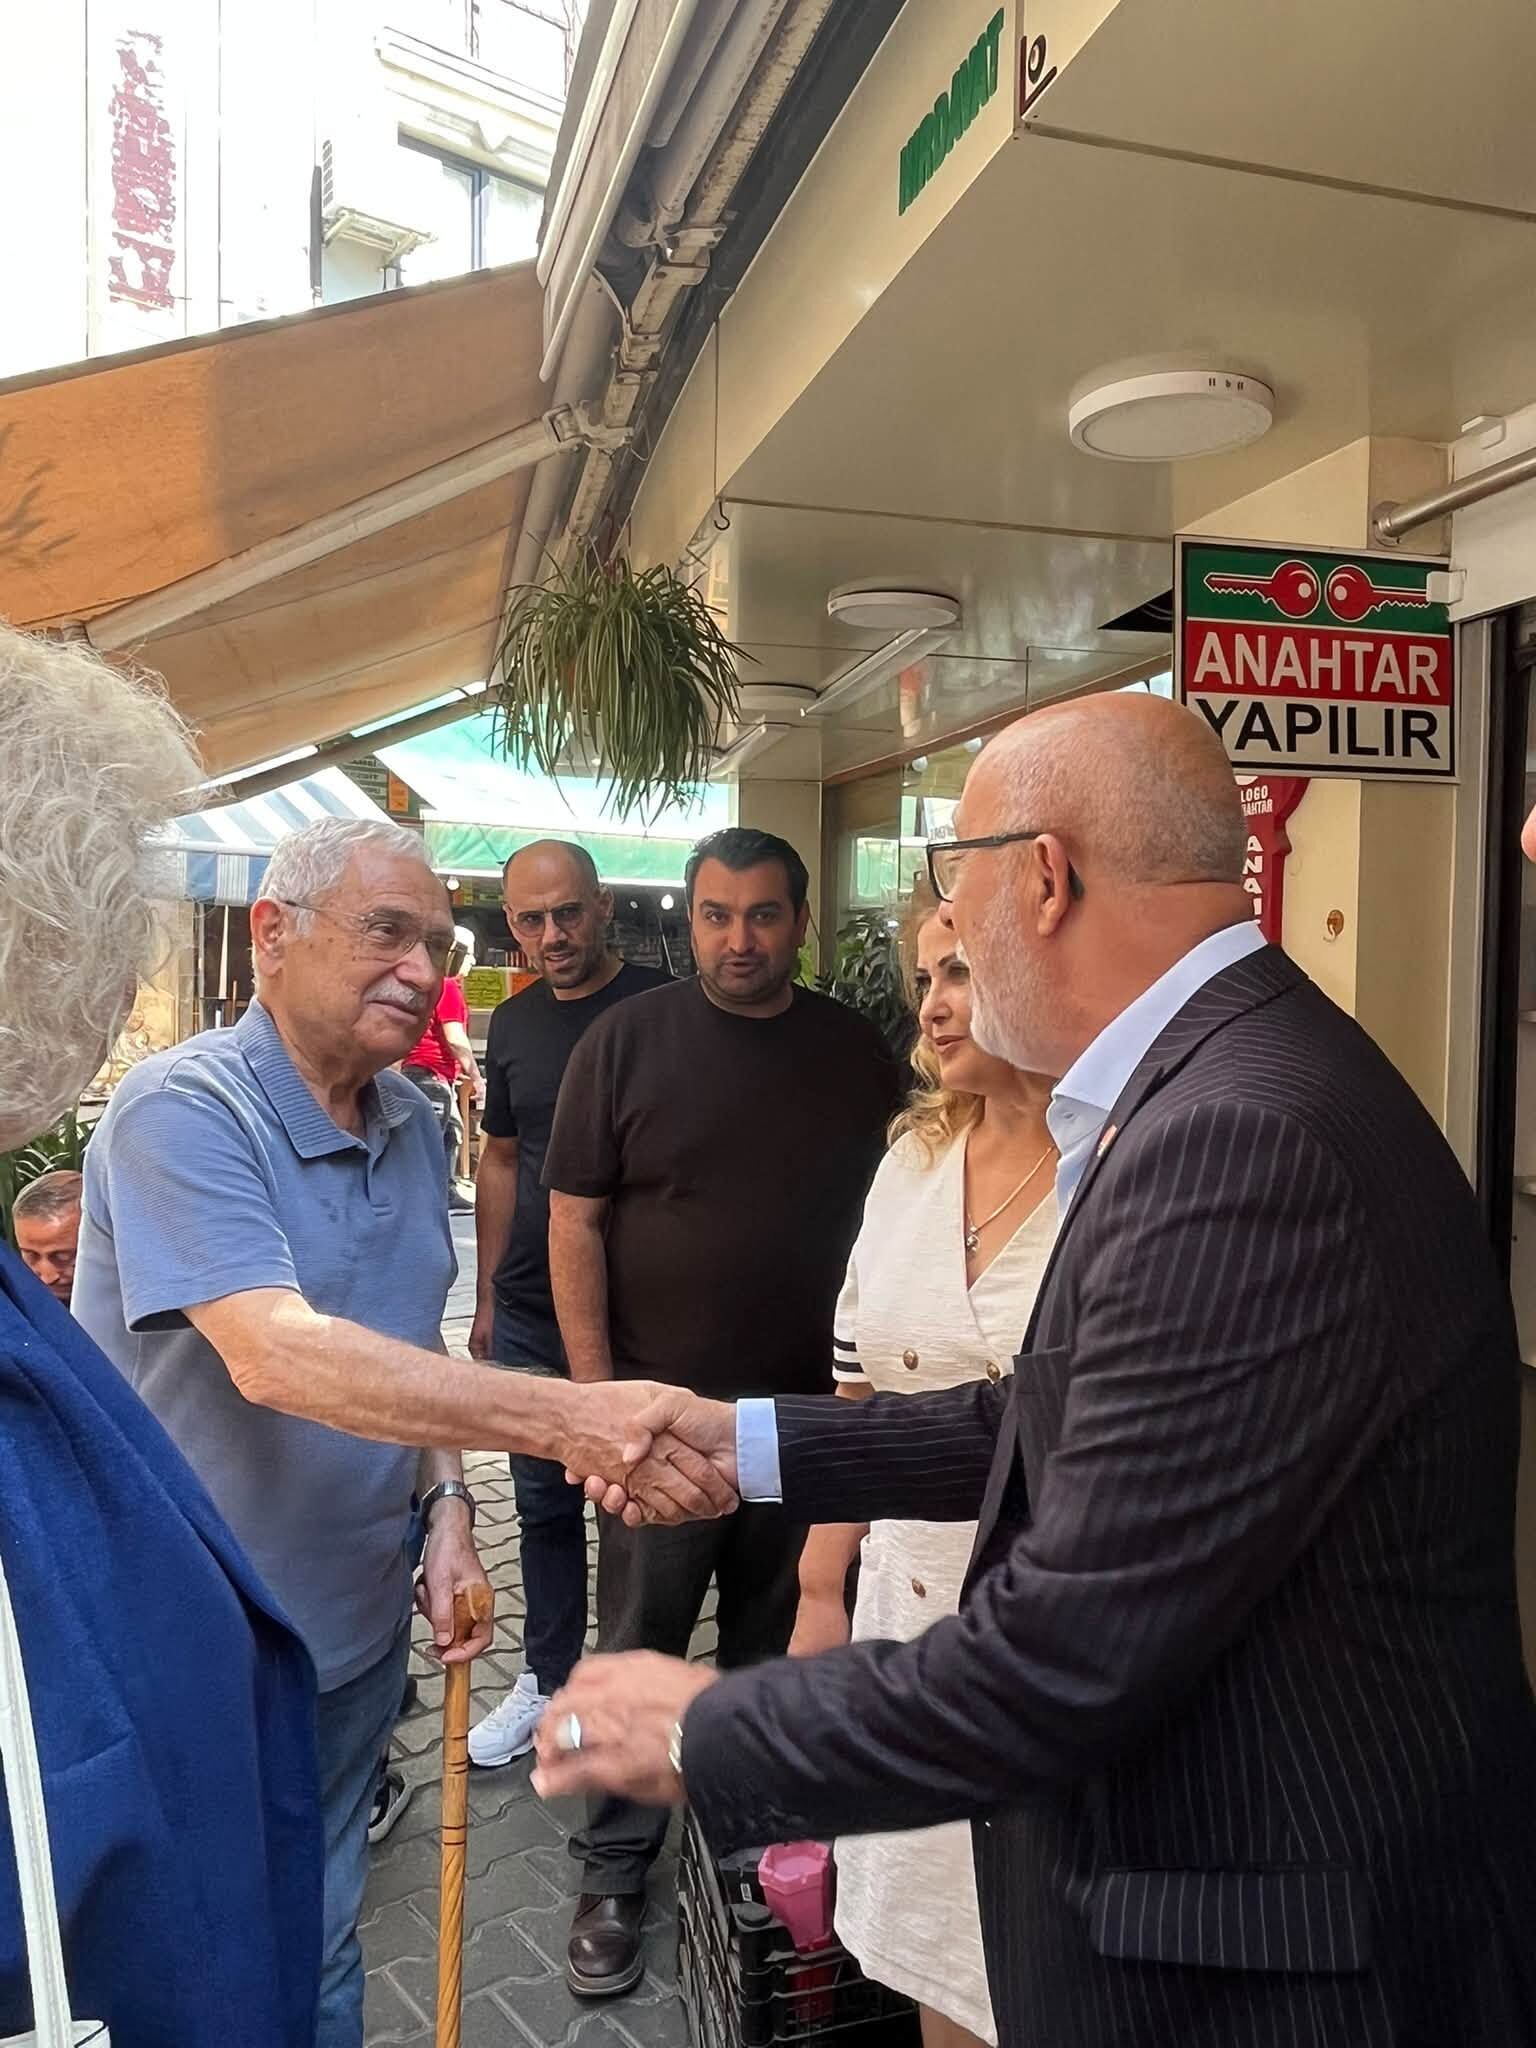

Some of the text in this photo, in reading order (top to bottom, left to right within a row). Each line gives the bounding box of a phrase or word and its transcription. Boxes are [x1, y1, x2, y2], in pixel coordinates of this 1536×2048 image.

[1193, 631, 1440, 697] ANAHTAR
[1195, 698, 1441, 759] YAPILIR
[1241, 785, 1268, 803] LOGO
